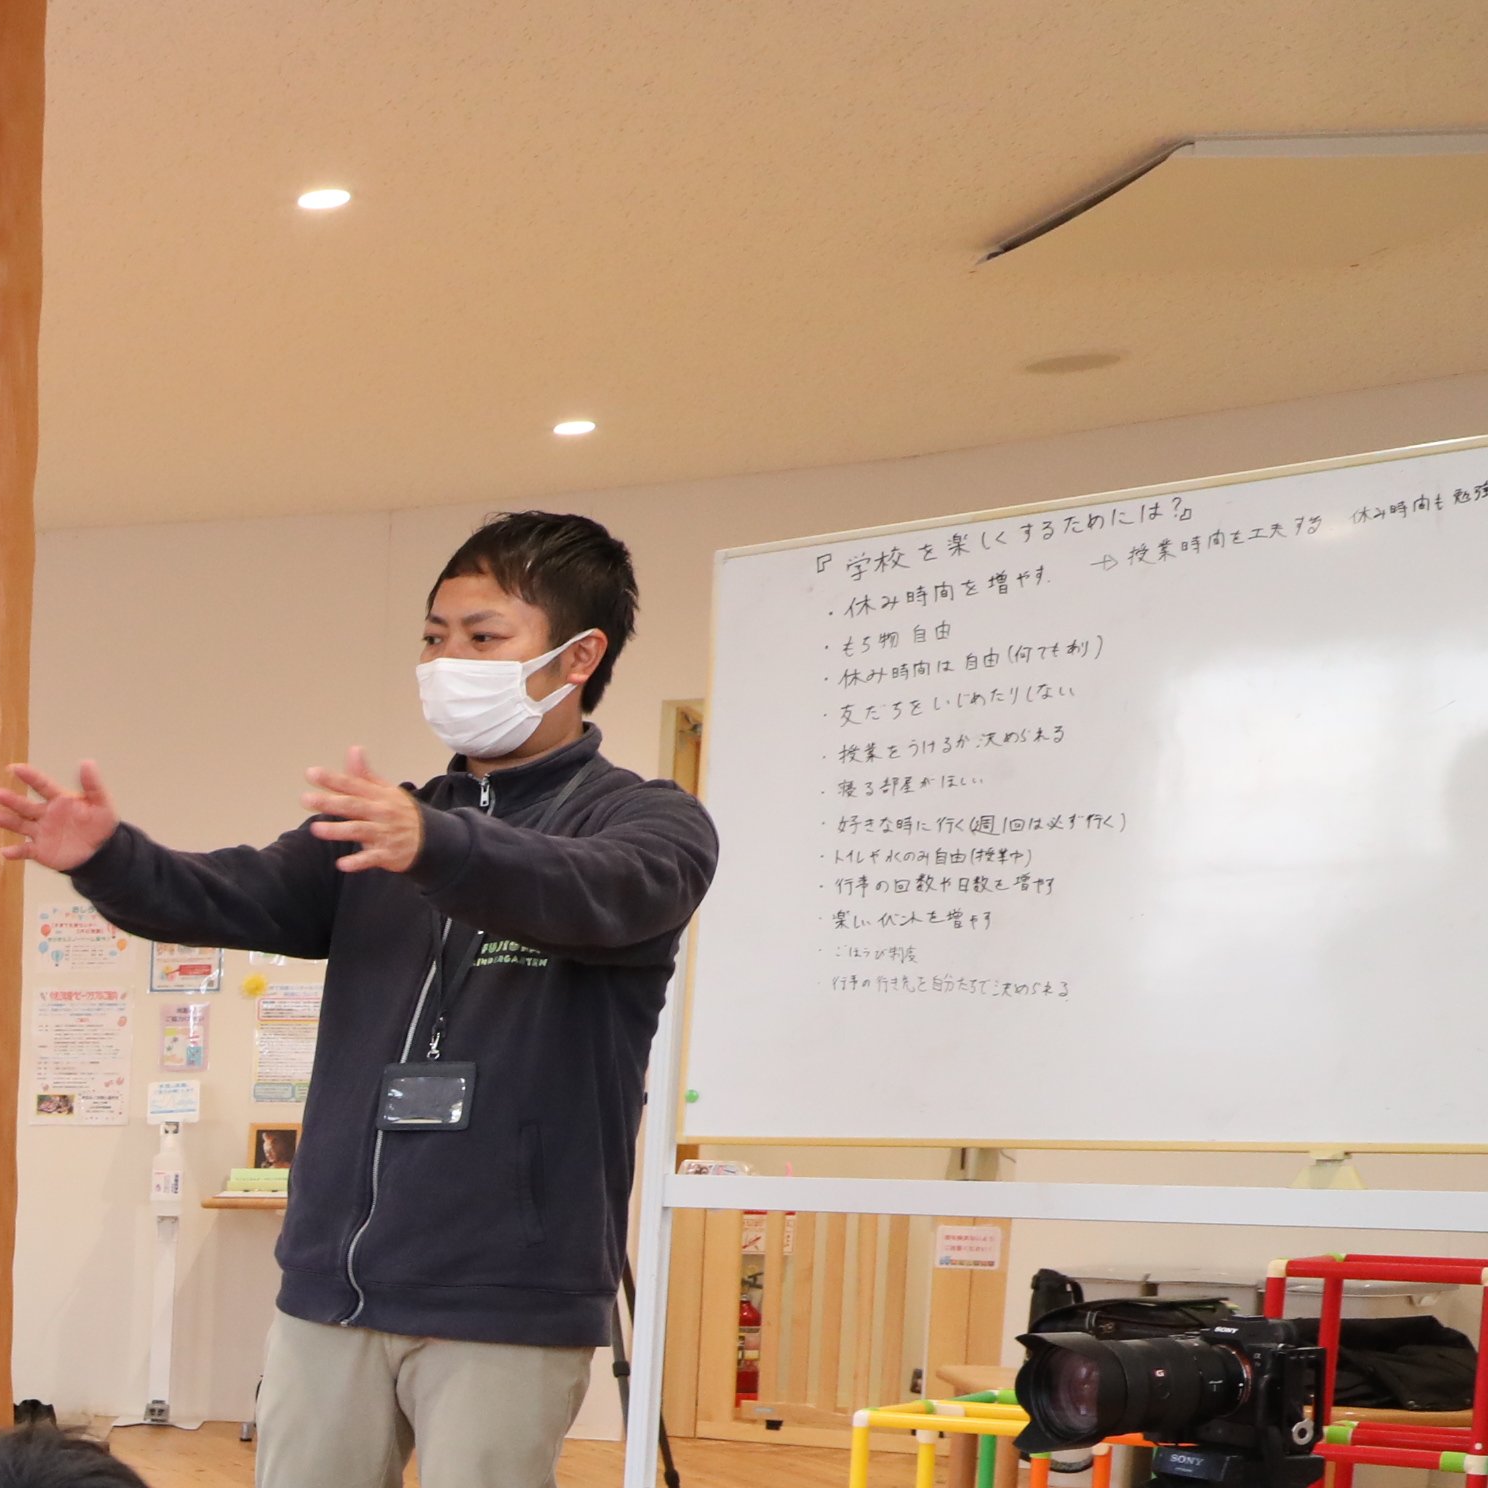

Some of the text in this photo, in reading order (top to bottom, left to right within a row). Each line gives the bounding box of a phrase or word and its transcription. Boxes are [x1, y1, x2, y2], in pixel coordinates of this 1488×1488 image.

[472, 955, 549, 967] INDERGARTEN
[1214, 1326, 1239, 1334] SONY
[1170, 1453, 1205, 1466] SONY
